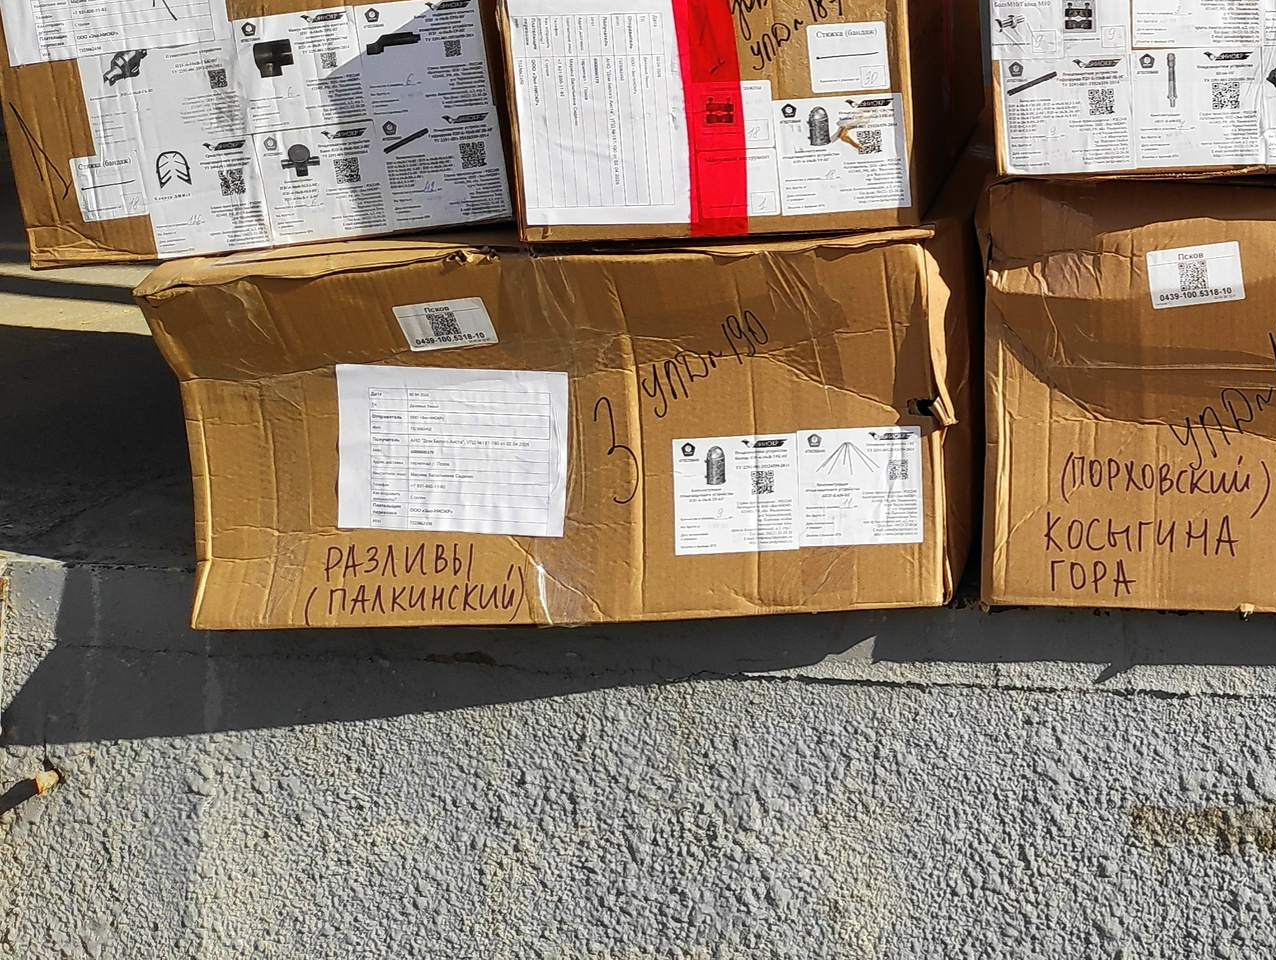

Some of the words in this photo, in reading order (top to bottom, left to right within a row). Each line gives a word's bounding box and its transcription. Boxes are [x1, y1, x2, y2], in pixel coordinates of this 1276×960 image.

[1178, 253, 1204, 261] Псков
[1159, 287, 1232, 301] 0439-100.5318-10
[416, 332, 485, 346] 0439-100.5318-10
[721, 310, 769, 365] 190
[1044, 511, 1240, 557] КОСЫГИНА
[324, 542, 475, 582] РАЗЛИВЫ
[1050, 558, 1137, 597] ГОРА
